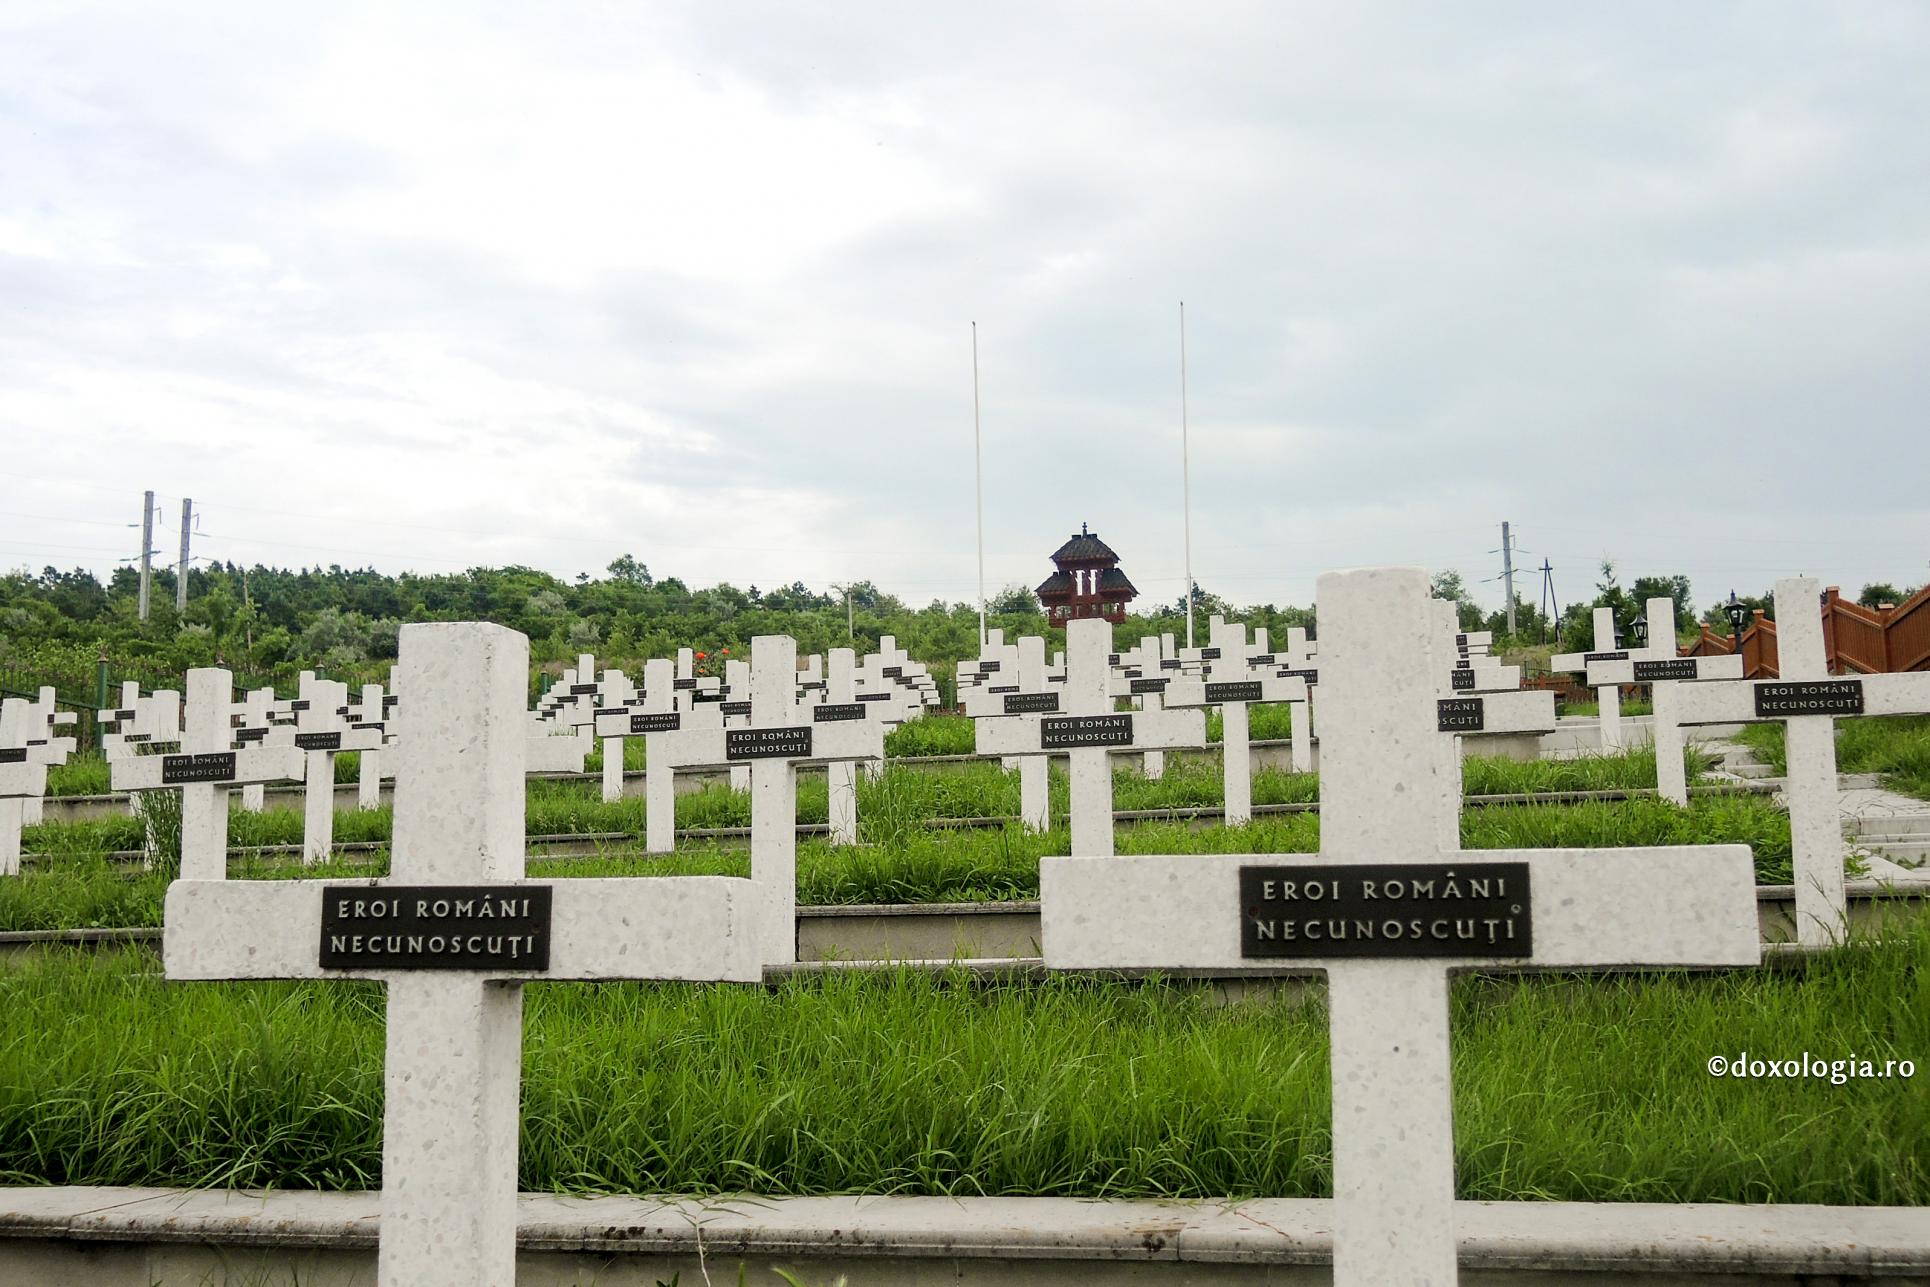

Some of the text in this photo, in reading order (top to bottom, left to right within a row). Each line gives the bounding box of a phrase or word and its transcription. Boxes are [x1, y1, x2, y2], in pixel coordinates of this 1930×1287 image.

[1764, 683, 1855, 696] EROI ROMÂNI
[1047, 717, 1126, 730] EROI ROMÂNI
[732, 730, 804, 742] EROI ROMÂNI
[1263, 872, 1505, 900] EROI ROMÂNI
[337, 894, 530, 919] EROI ROMÂNI
